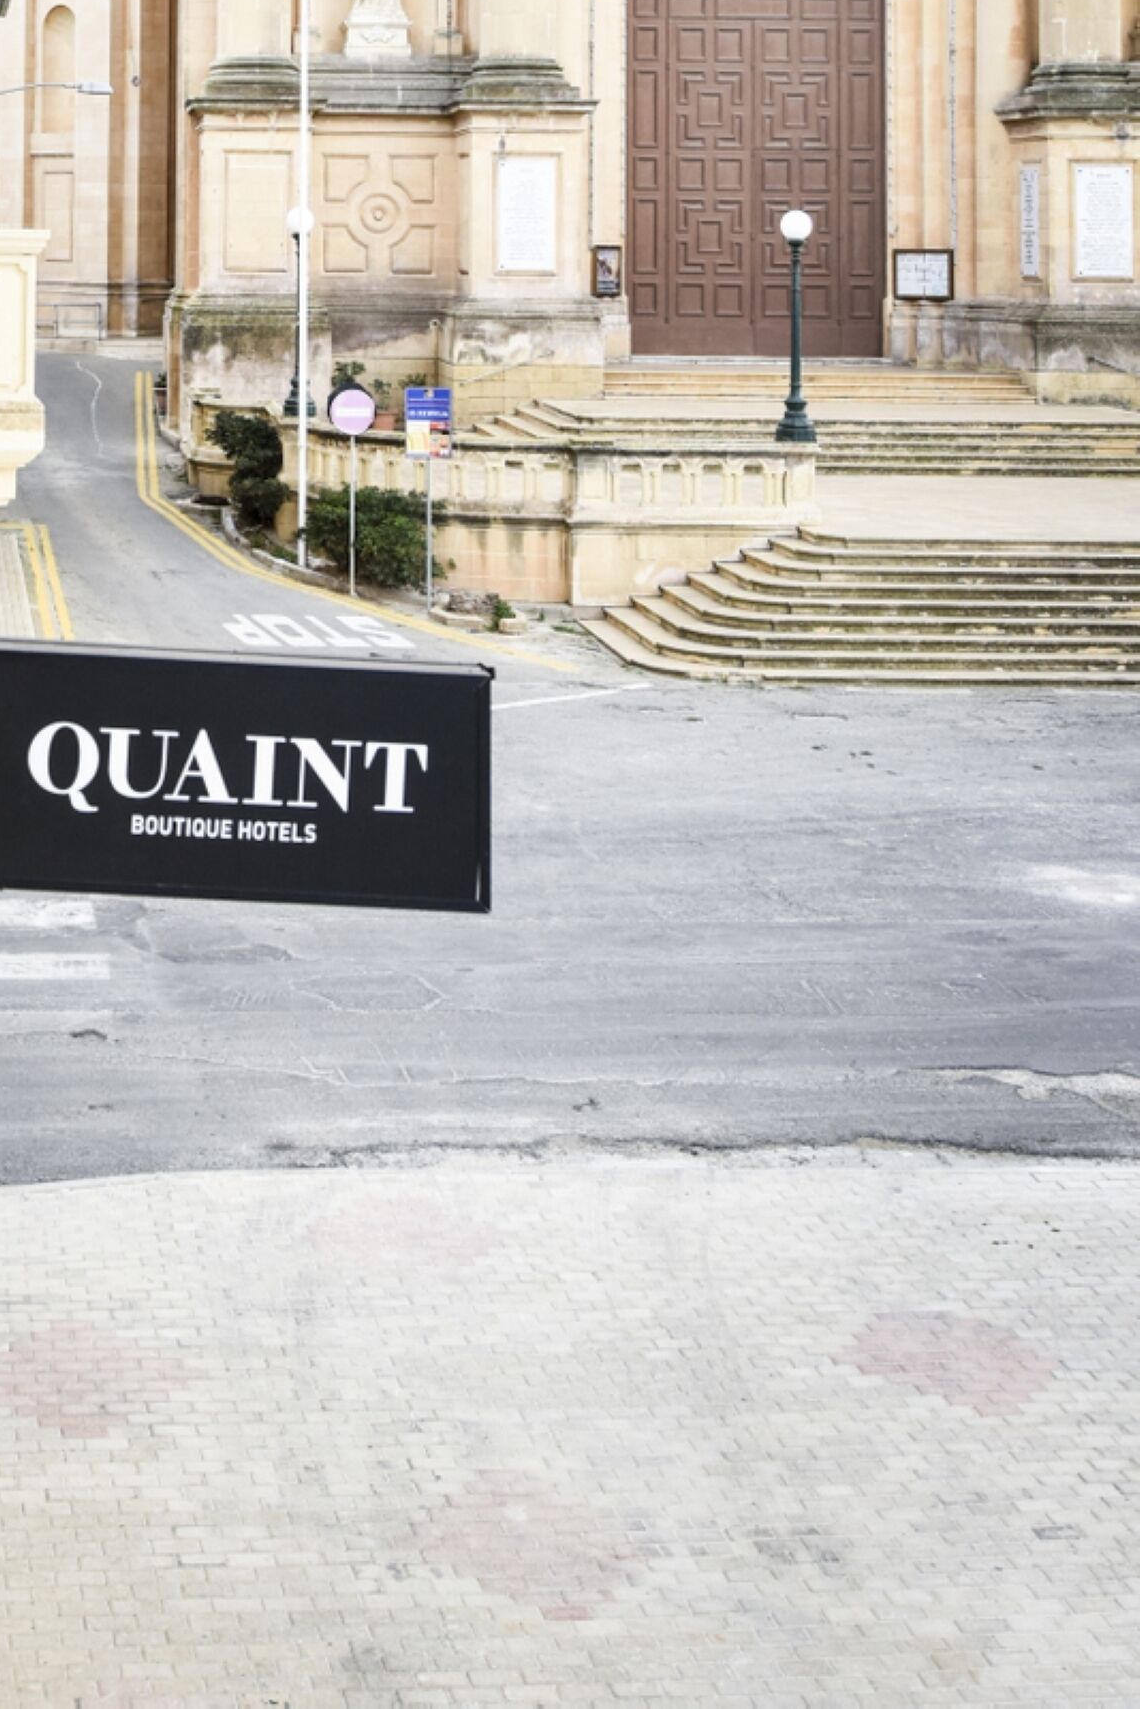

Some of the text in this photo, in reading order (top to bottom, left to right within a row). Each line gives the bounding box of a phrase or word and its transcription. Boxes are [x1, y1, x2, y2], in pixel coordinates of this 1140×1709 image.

[222, 613, 417, 648] STOP
[26, 720, 429, 814] QUAINT
[130, 813, 318, 844] BOUTIQUE HOTELS
